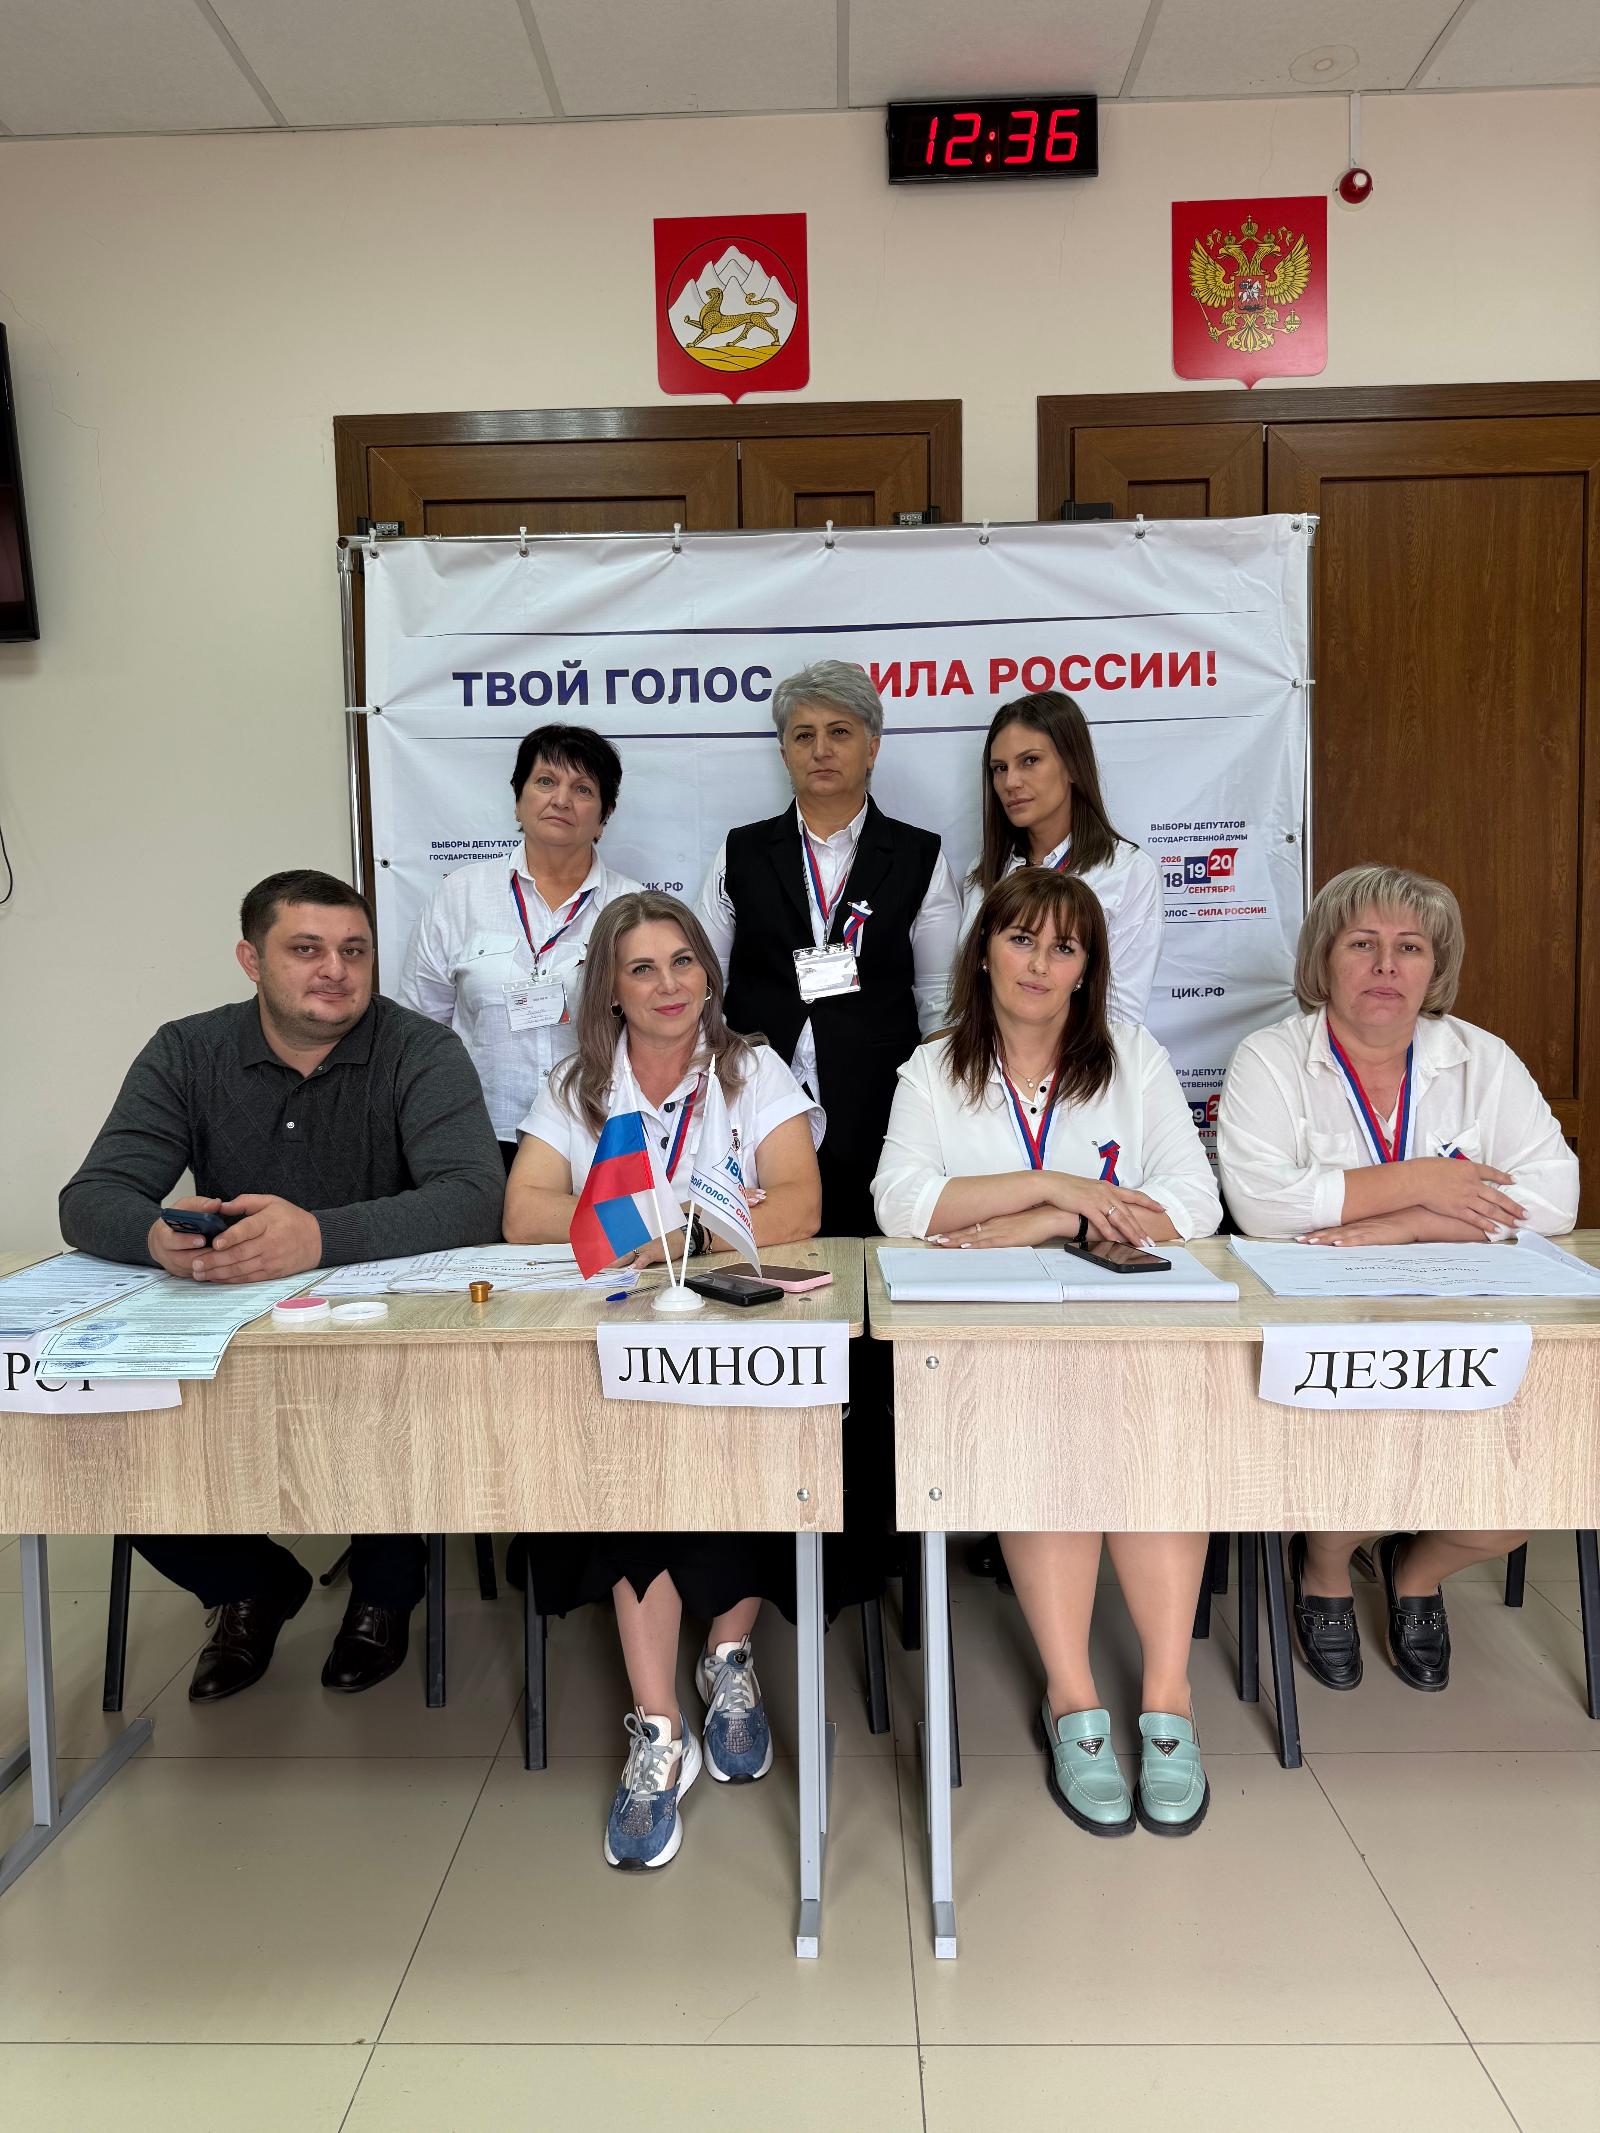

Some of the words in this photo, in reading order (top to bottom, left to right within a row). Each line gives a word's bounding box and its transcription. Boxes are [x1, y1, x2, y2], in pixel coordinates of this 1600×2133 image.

[926, 109, 1080, 166] 12:36
[452, 659, 589, 707] ТВОЙ
[605, 665, 773, 705] ГОЛОС
[853, 659, 975, 698] ИЛА
[989, 650, 1218, 695] РОССИИ!
[1150, 823, 1192, 831] ВЫБОРЫ
[1193, 821, 1246, 831] ДЕПУТАТОВ
[1147, 833, 1225, 844] ГОСУДАРСТВЕННОЙ
[1225, 833, 1248, 841] ДУМЫ
[431, 841, 471, 849] ВЫБОРЫ
[1163, 872, 1183, 888] 18
[1186, 862, 1206, 879] 19
[1210, 855, 1232, 871] 20
[641, 881, 684, 892] ИК.РФ
[1188, 885, 1236, 894] СЕНТЯБРЯ
[1197, 908, 1223, 916] СИЛА
[1225, 907, 1267, 915] РОССИИ!
[1171, 986, 1225, 1000] ЦИК.РФ
[1191, 1068, 1227, 1078] ДЕПУТ
[1179, 1080, 1224, 1088] СТВЕННОЙ
[702, 1183, 730, 1205] ГОЛОС
[618, 1345, 828, 1387] ЛМНОП
[1293, 1347, 1499, 1399] ДЕЗИК
